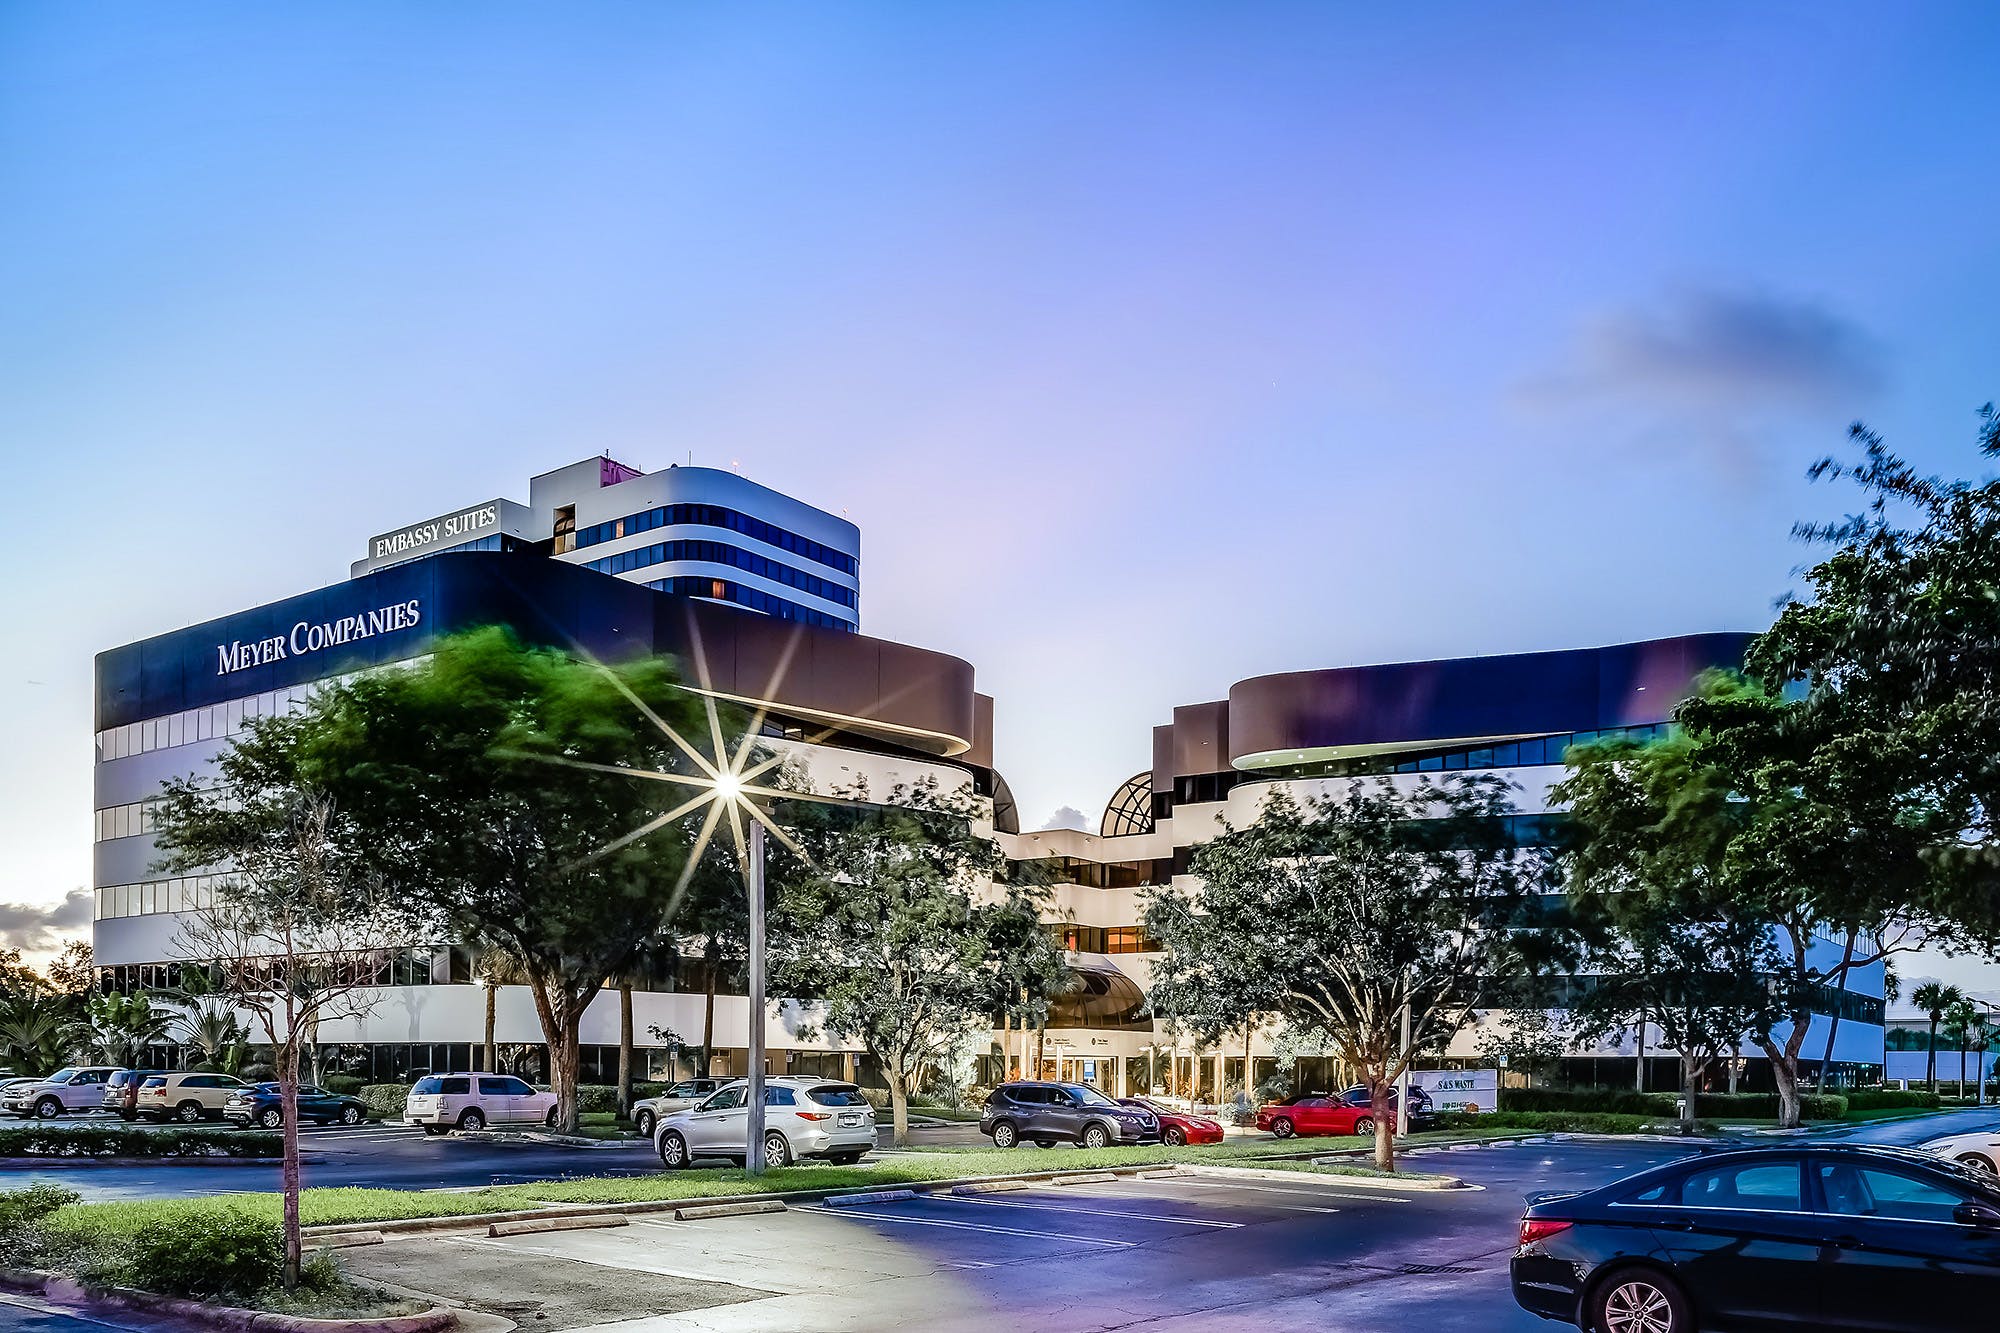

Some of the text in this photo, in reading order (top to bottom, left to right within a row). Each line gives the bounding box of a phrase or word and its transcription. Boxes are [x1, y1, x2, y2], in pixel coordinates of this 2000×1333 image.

[375, 506, 496, 558] EMBASSY SUITES
[217, 600, 421, 675] MEYER COMPANIES
[1454, 1080, 1475, 1089] WASTE
